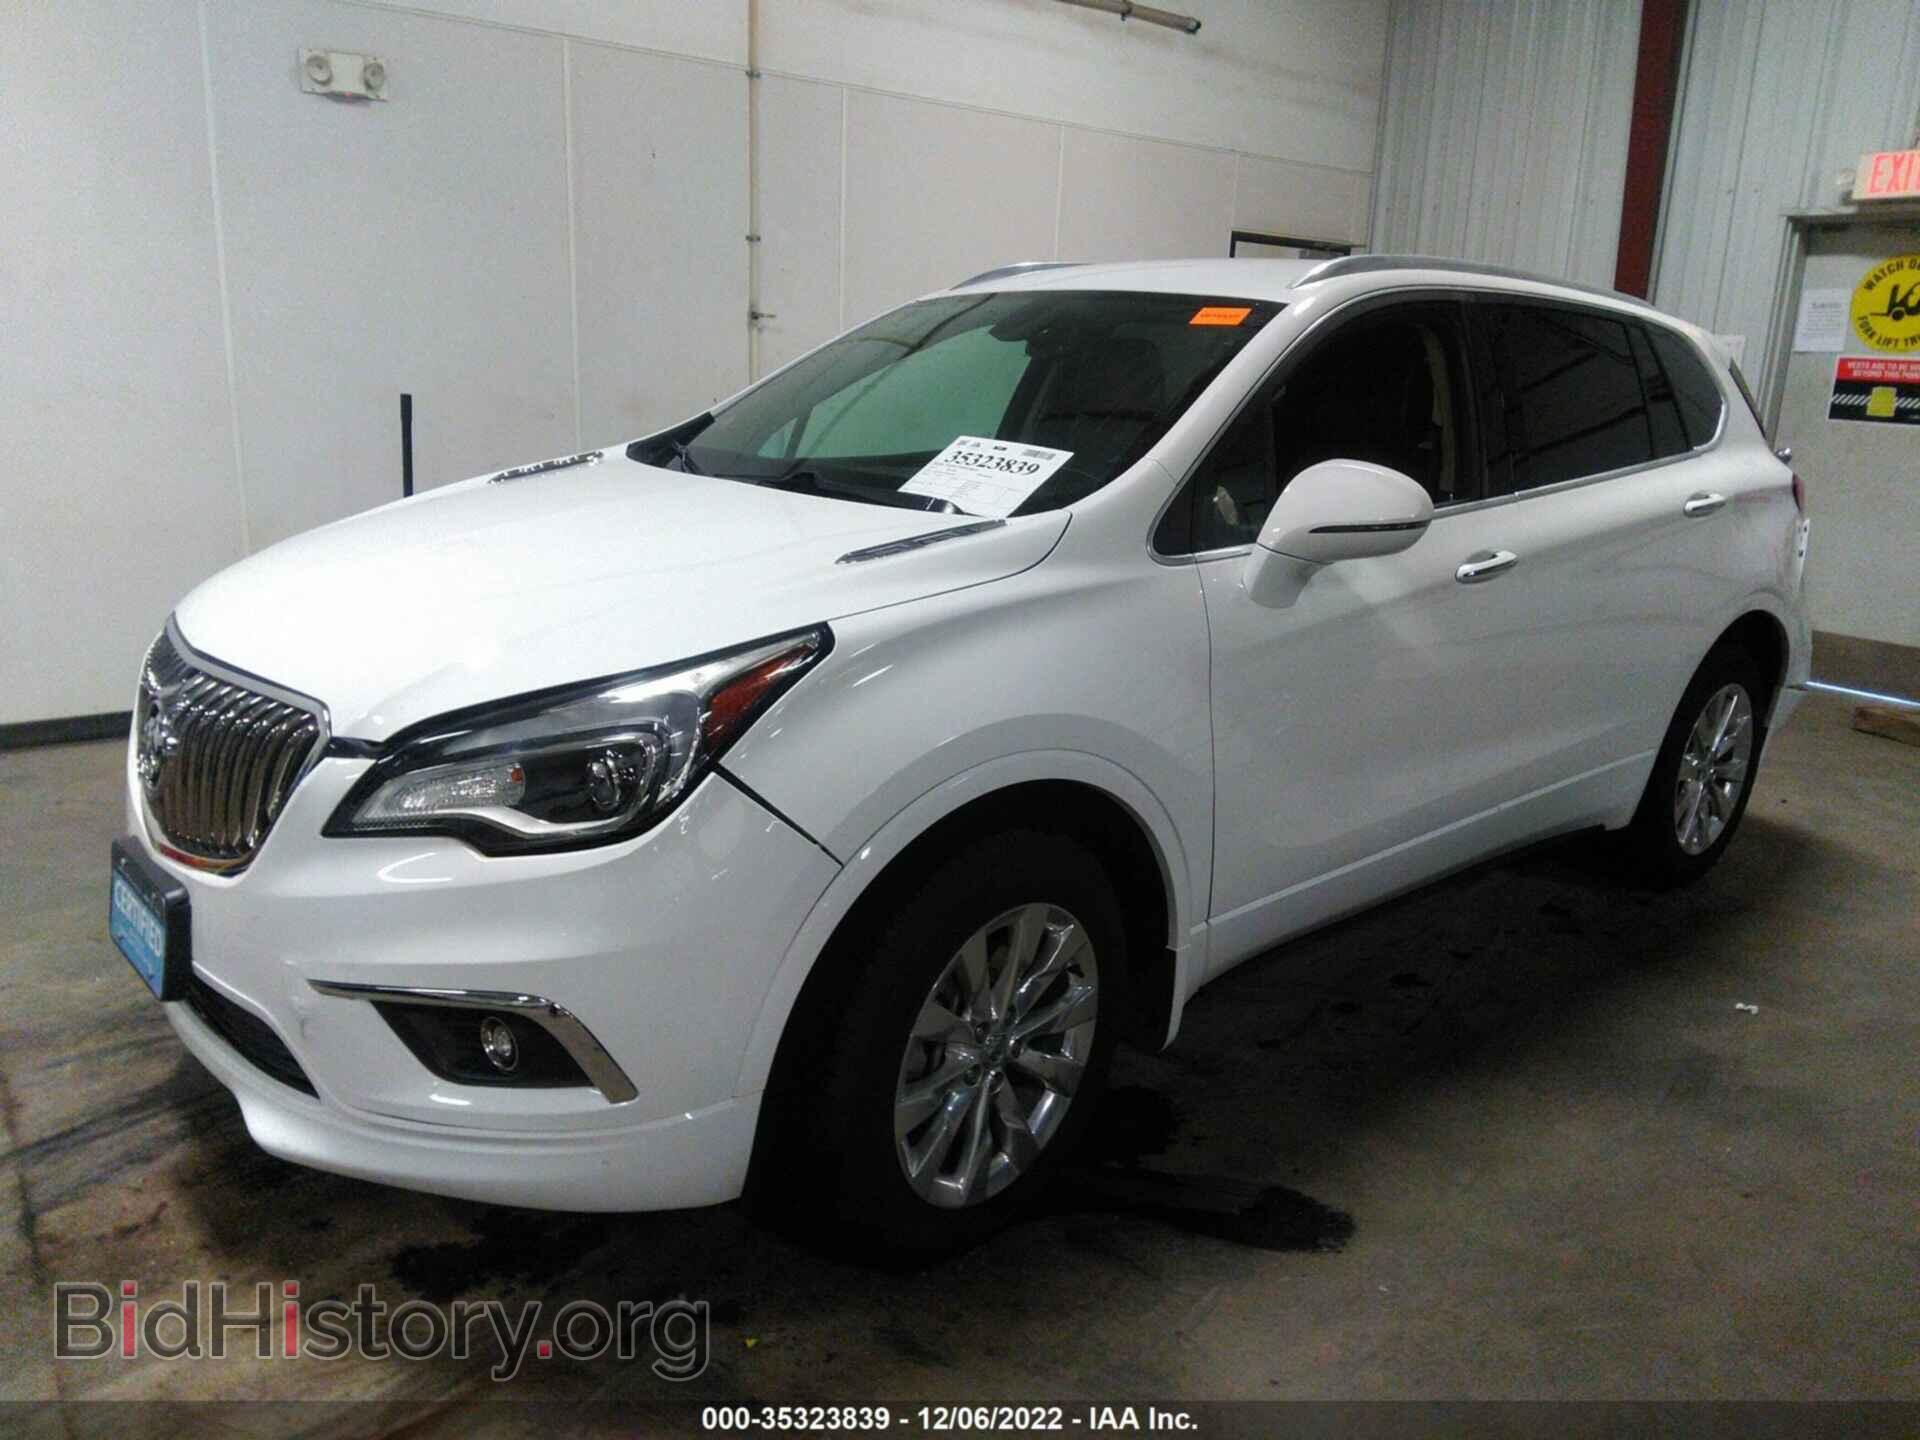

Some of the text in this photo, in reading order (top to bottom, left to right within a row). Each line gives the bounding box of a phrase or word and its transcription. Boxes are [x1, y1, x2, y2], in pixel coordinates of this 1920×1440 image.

[1864, 259, 1904, 291] WATCH
[1857, 315, 1877, 340] FORK
[1876, 336, 1899, 348] LIFT
[1903, 335, 1920, 347] TR
[944, 450, 1041, 476] 35323839
[114, 879, 162, 957] CERTIFIED
